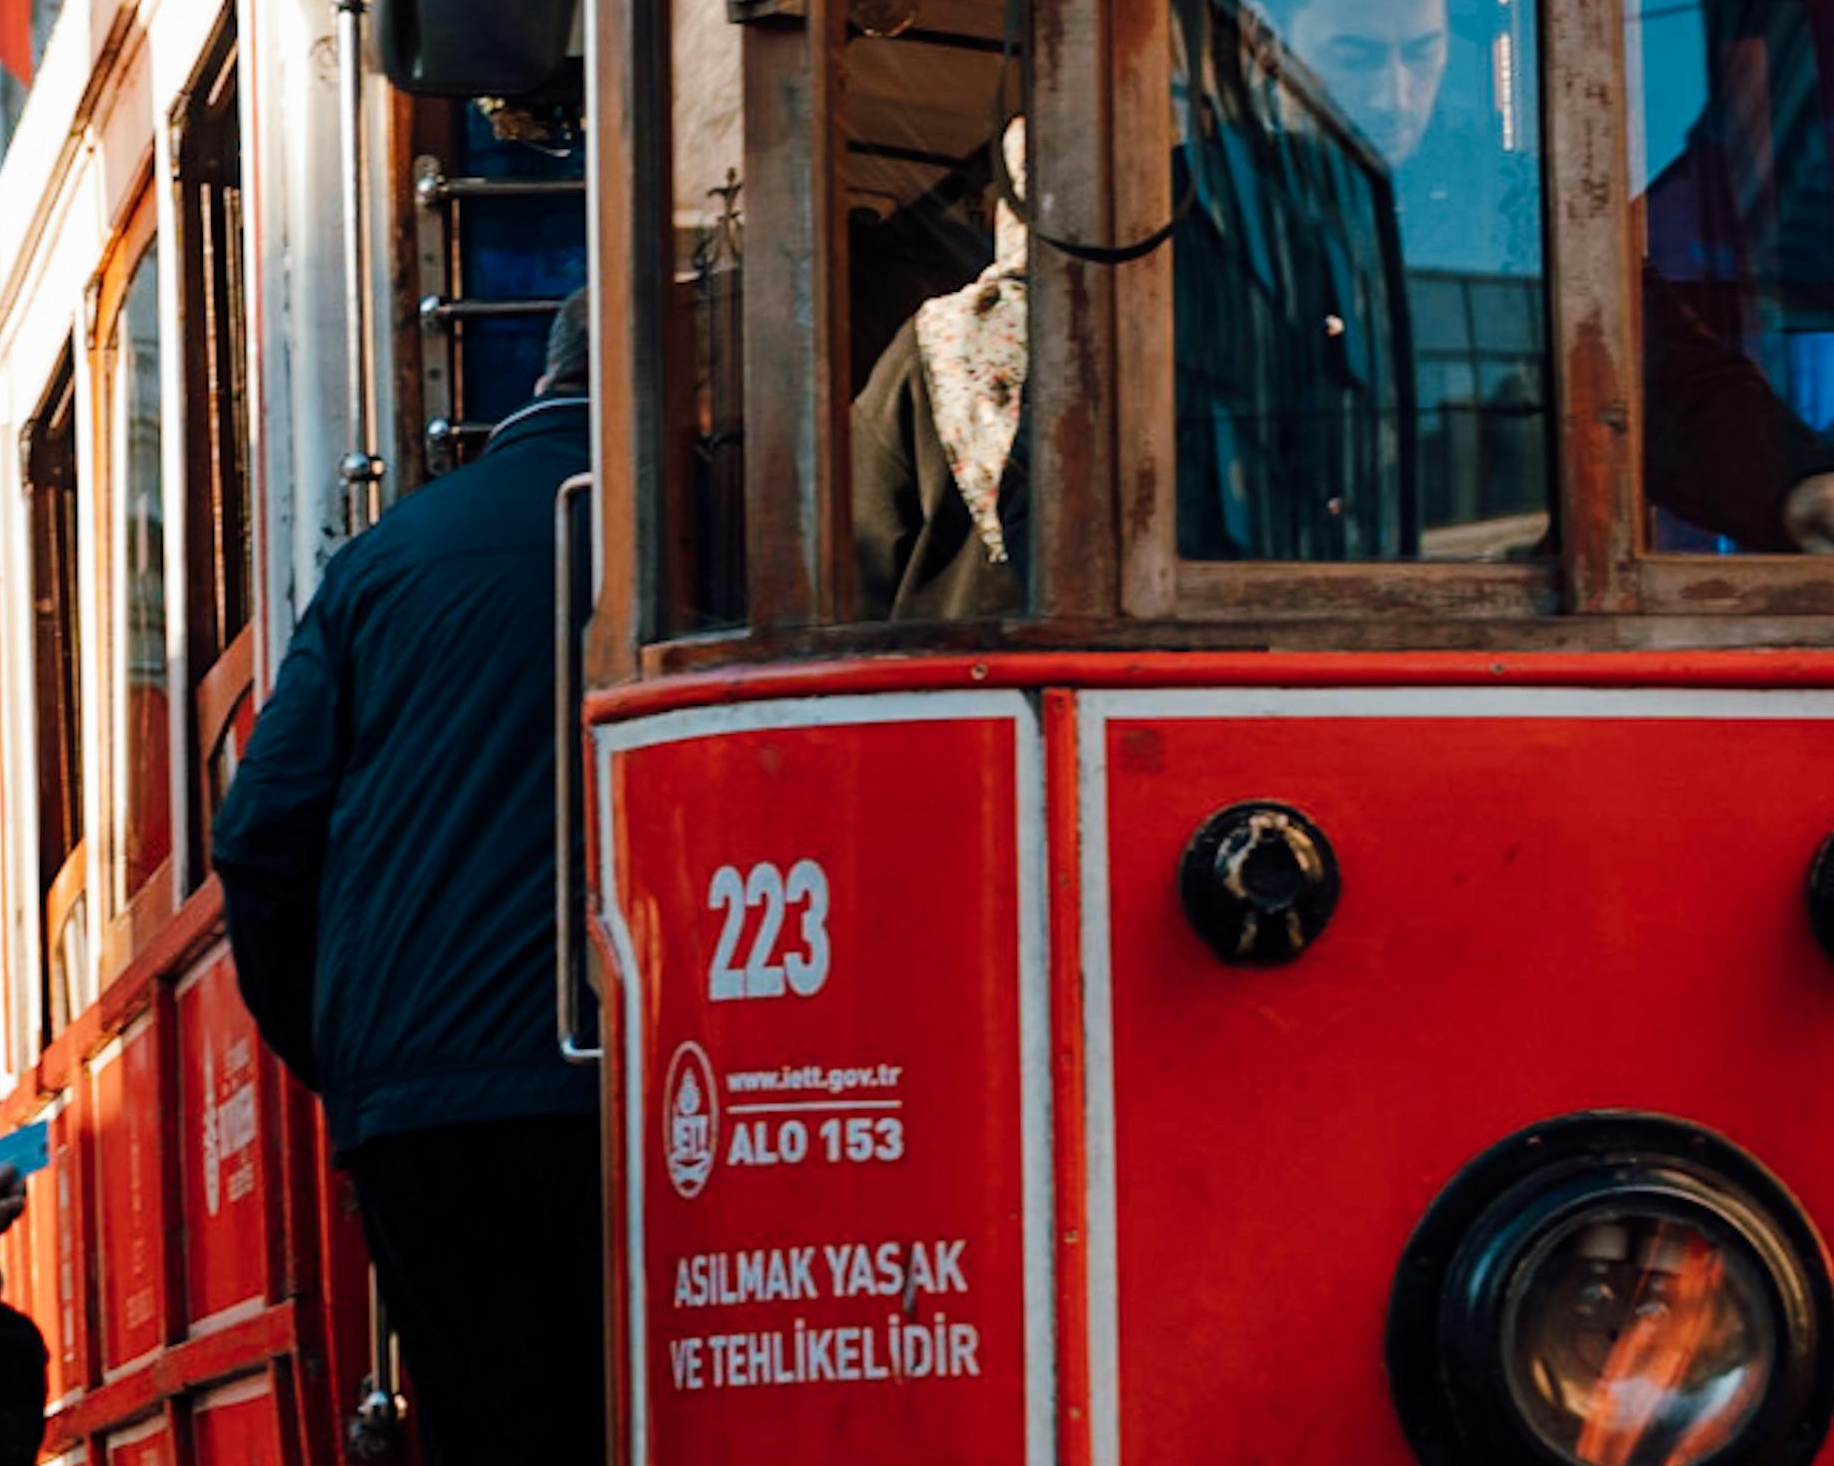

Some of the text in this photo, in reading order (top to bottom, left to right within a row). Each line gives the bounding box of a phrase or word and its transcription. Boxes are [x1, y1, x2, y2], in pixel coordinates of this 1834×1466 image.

[708, 858, 830, 1001] 223
[727, 1118, 904, 1166] ALO 153
[673, 1239, 968, 1309] ASILMAK YASAK
[670, 1312, 980, 1390] VE TEHLİKELİDİR
